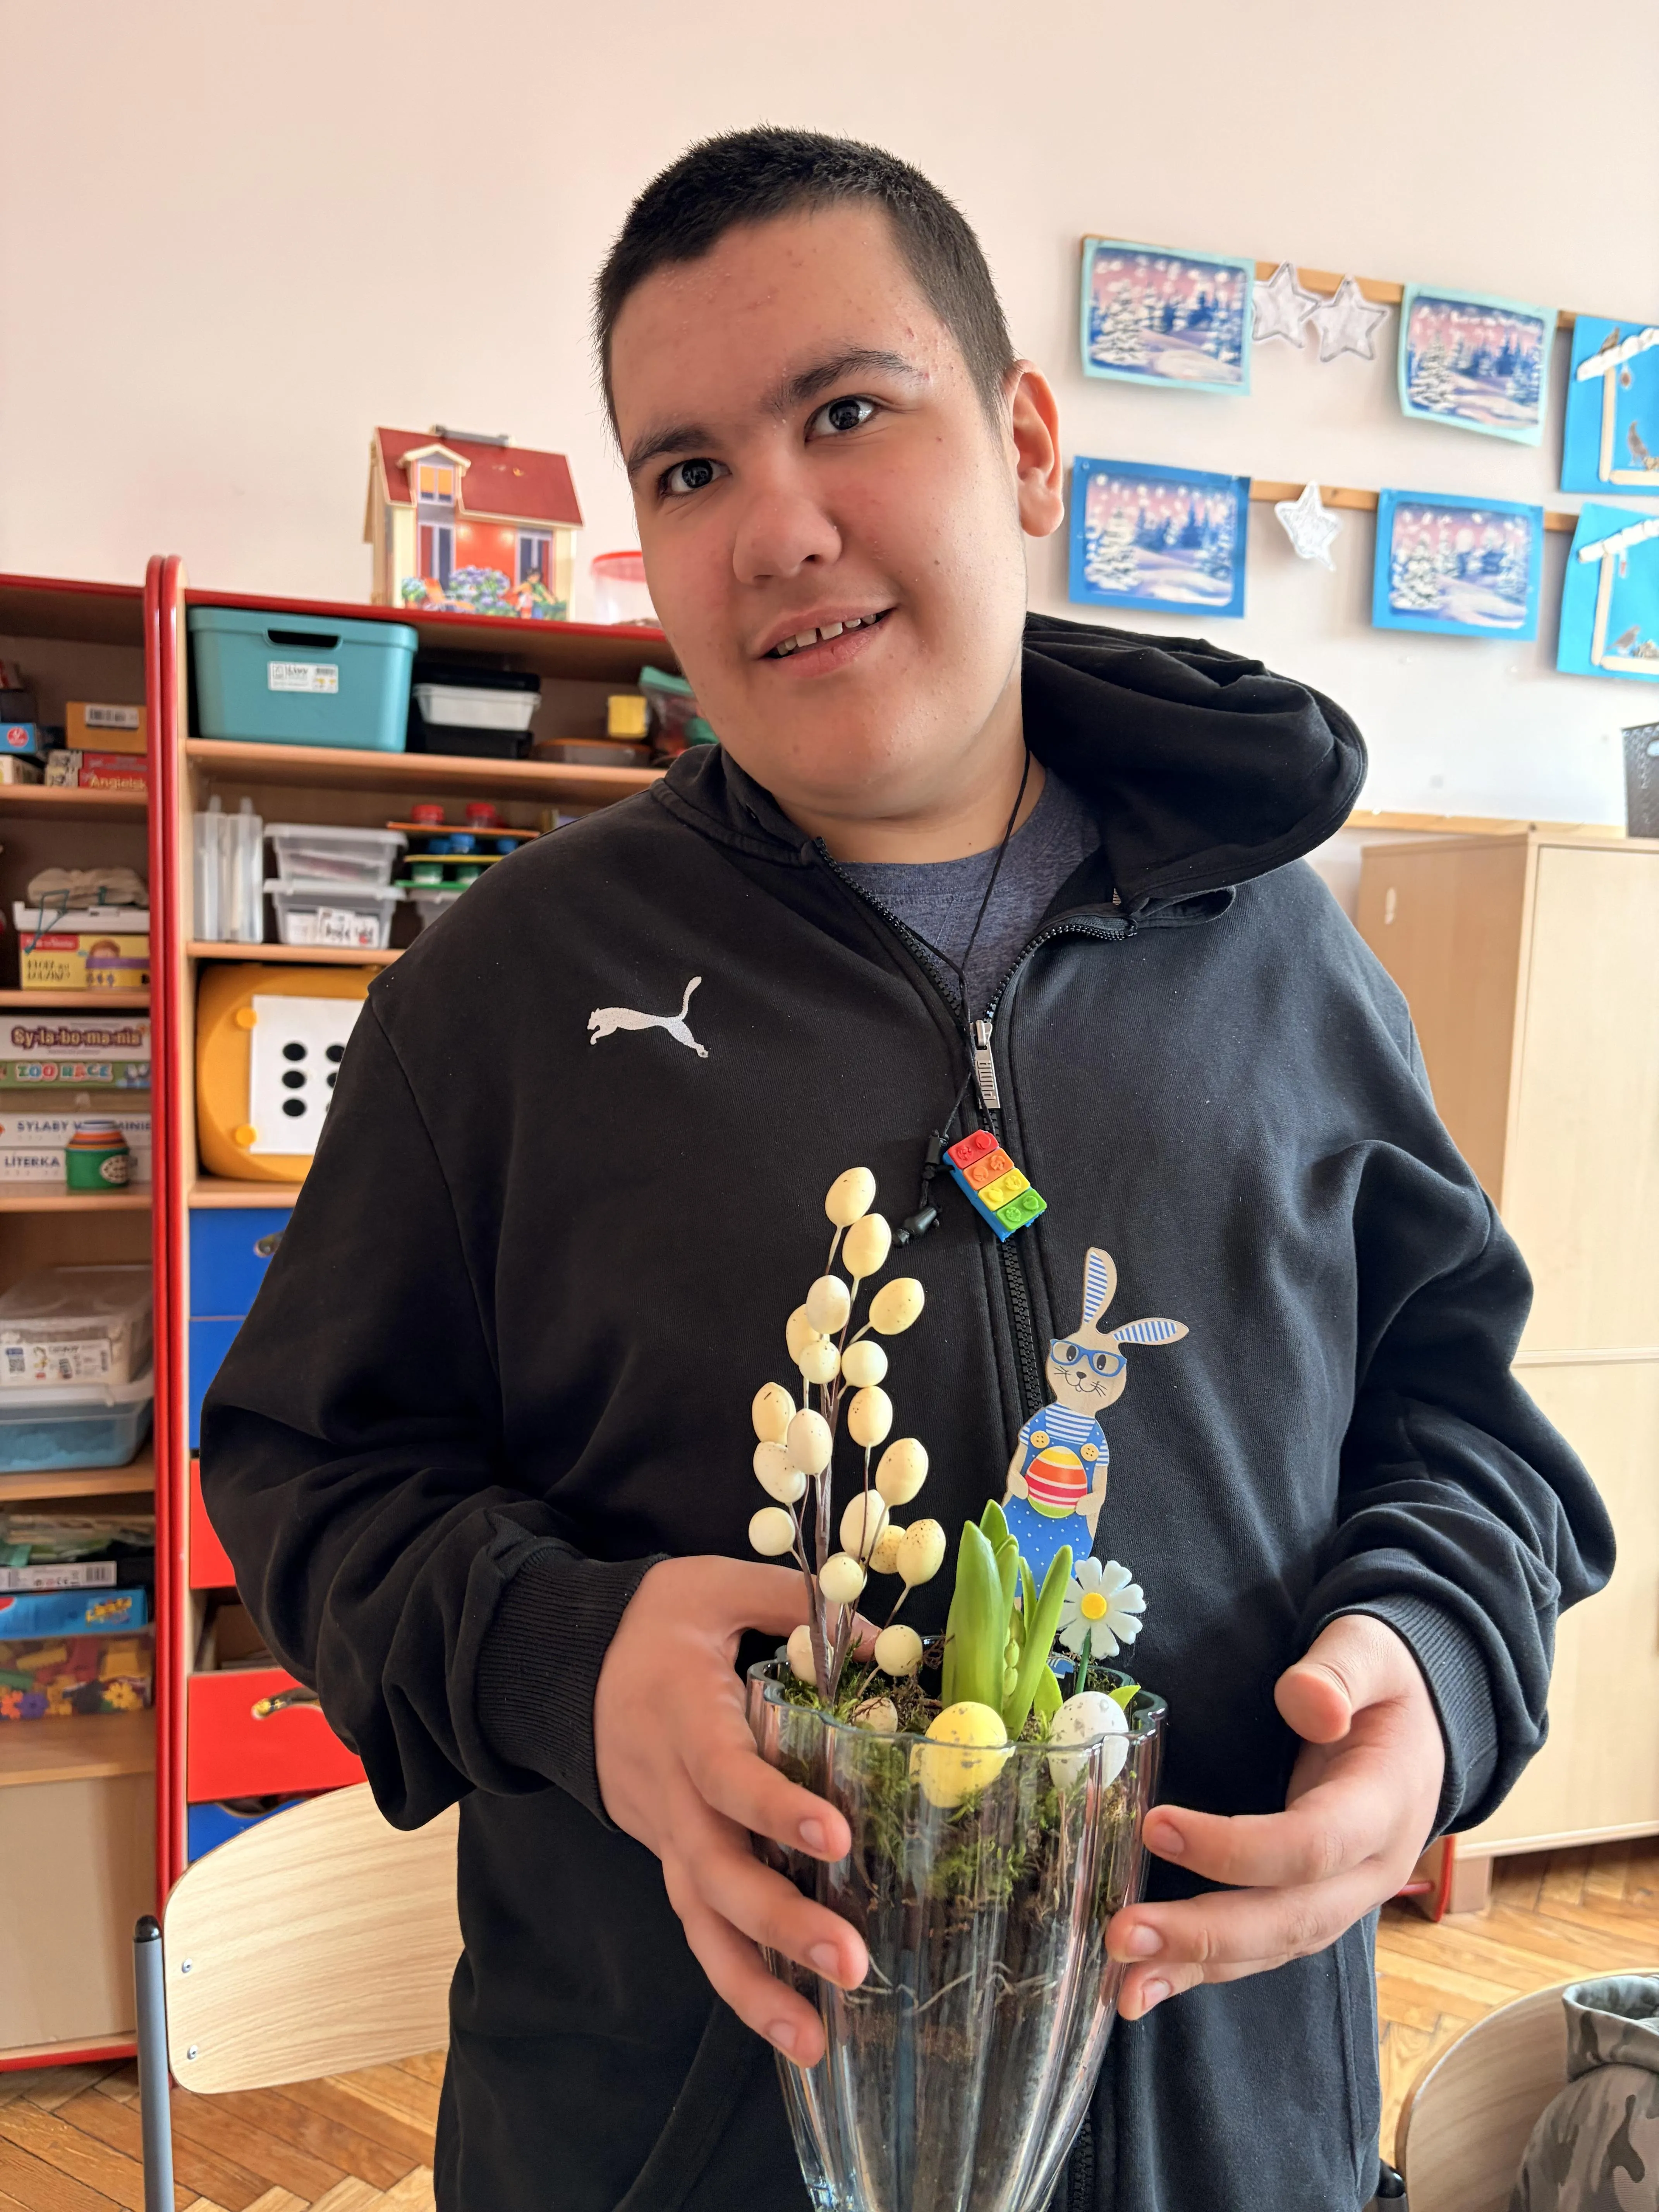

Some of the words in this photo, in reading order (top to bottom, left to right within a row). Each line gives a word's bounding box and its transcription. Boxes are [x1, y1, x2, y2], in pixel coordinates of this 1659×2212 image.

[17, 1064, 56, 1079] ZOO
[61, 1064, 111, 1079] RACE
[977, 1060, 996, 1100] PUMA
[17, 1121, 69, 1132] SYLABY
